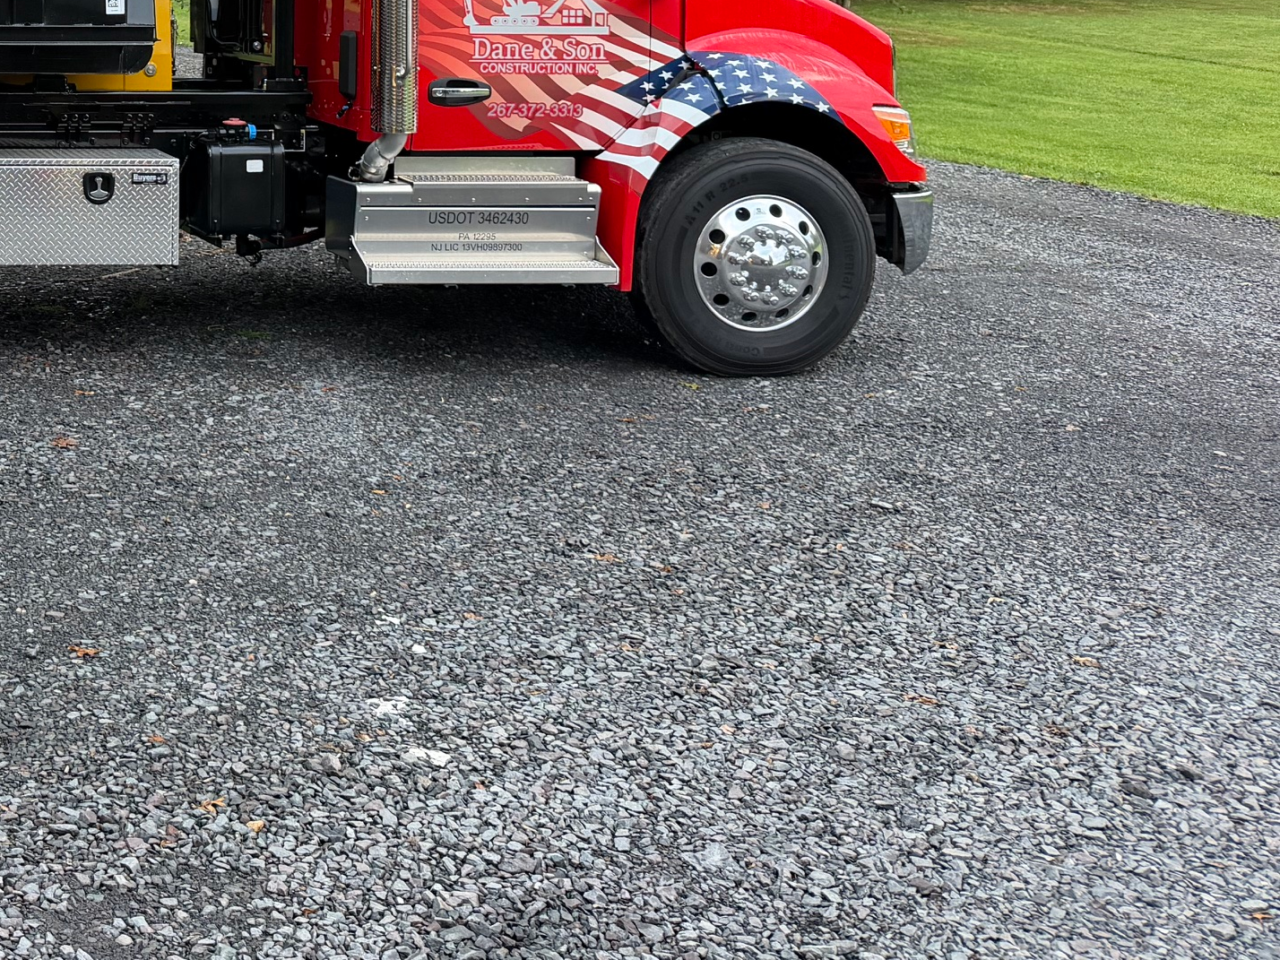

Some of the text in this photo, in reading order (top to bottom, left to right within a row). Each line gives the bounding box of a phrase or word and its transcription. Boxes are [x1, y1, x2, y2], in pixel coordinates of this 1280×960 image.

[472, 38, 606, 60] Dane & Son
[480, 62, 598, 75] CONSTRUCTION INC.
[487, 103, 583, 118] 267-372-3313
[428, 211, 529, 225] USDOT 3462430
[458, 233, 496, 241] PA 12295
[431, 243, 443, 251] NJ
[445, 243, 459, 251] LIC
